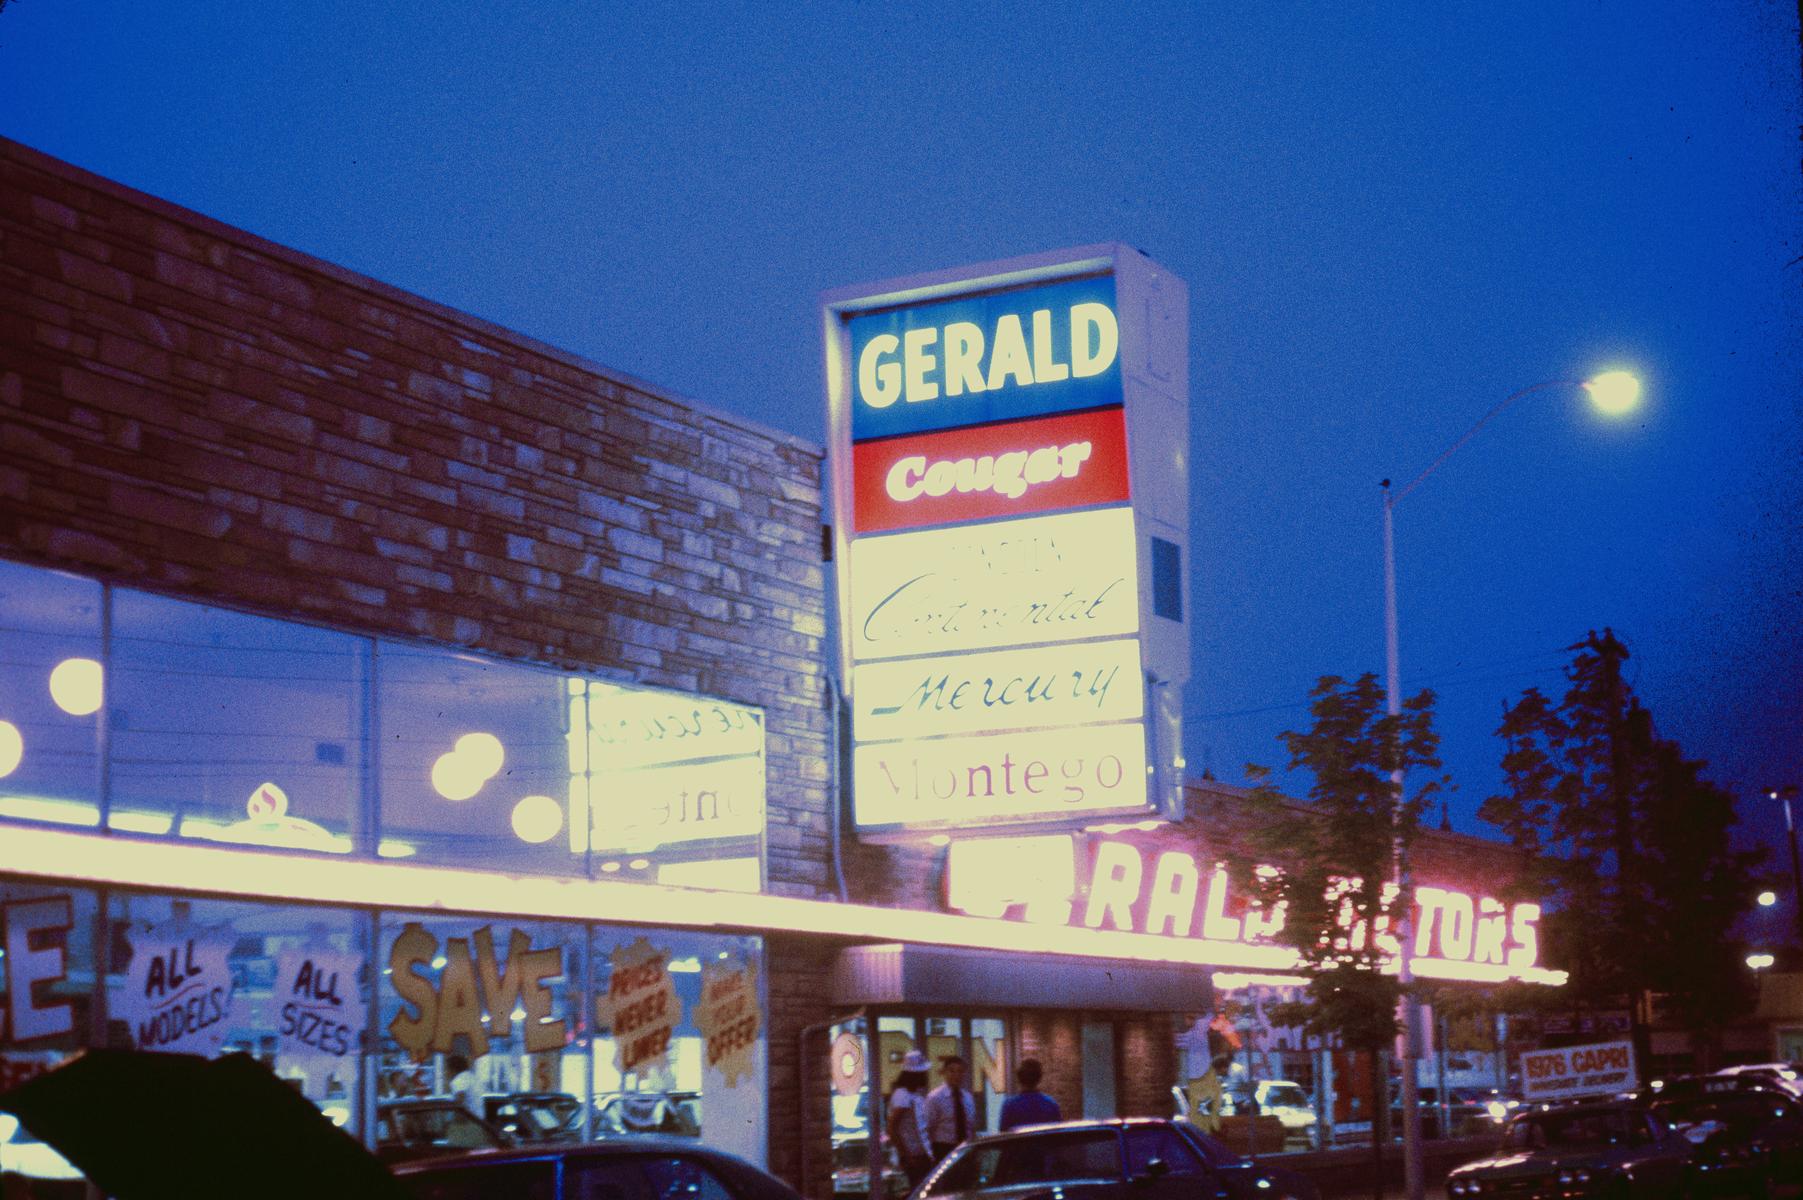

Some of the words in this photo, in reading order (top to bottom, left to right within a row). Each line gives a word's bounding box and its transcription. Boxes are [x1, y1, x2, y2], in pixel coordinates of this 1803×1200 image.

[858, 302, 1119, 409] GERALD
[885, 440, 1093, 502] Cougar
[870, 665, 1120, 716] Mercury
[878, 752, 1123, 803] Montego
[145, 939, 202, 998] ALL
[293, 959, 343, 1005] ALL
[138, 986, 223, 1046] MODELS
[280, 1002, 349, 1056] SIZES
[707, 1015, 756, 1067] OFFER
[831, 1031, 1006, 1097] OPEN
[1571, 1046, 1629, 1073] CAPRI
